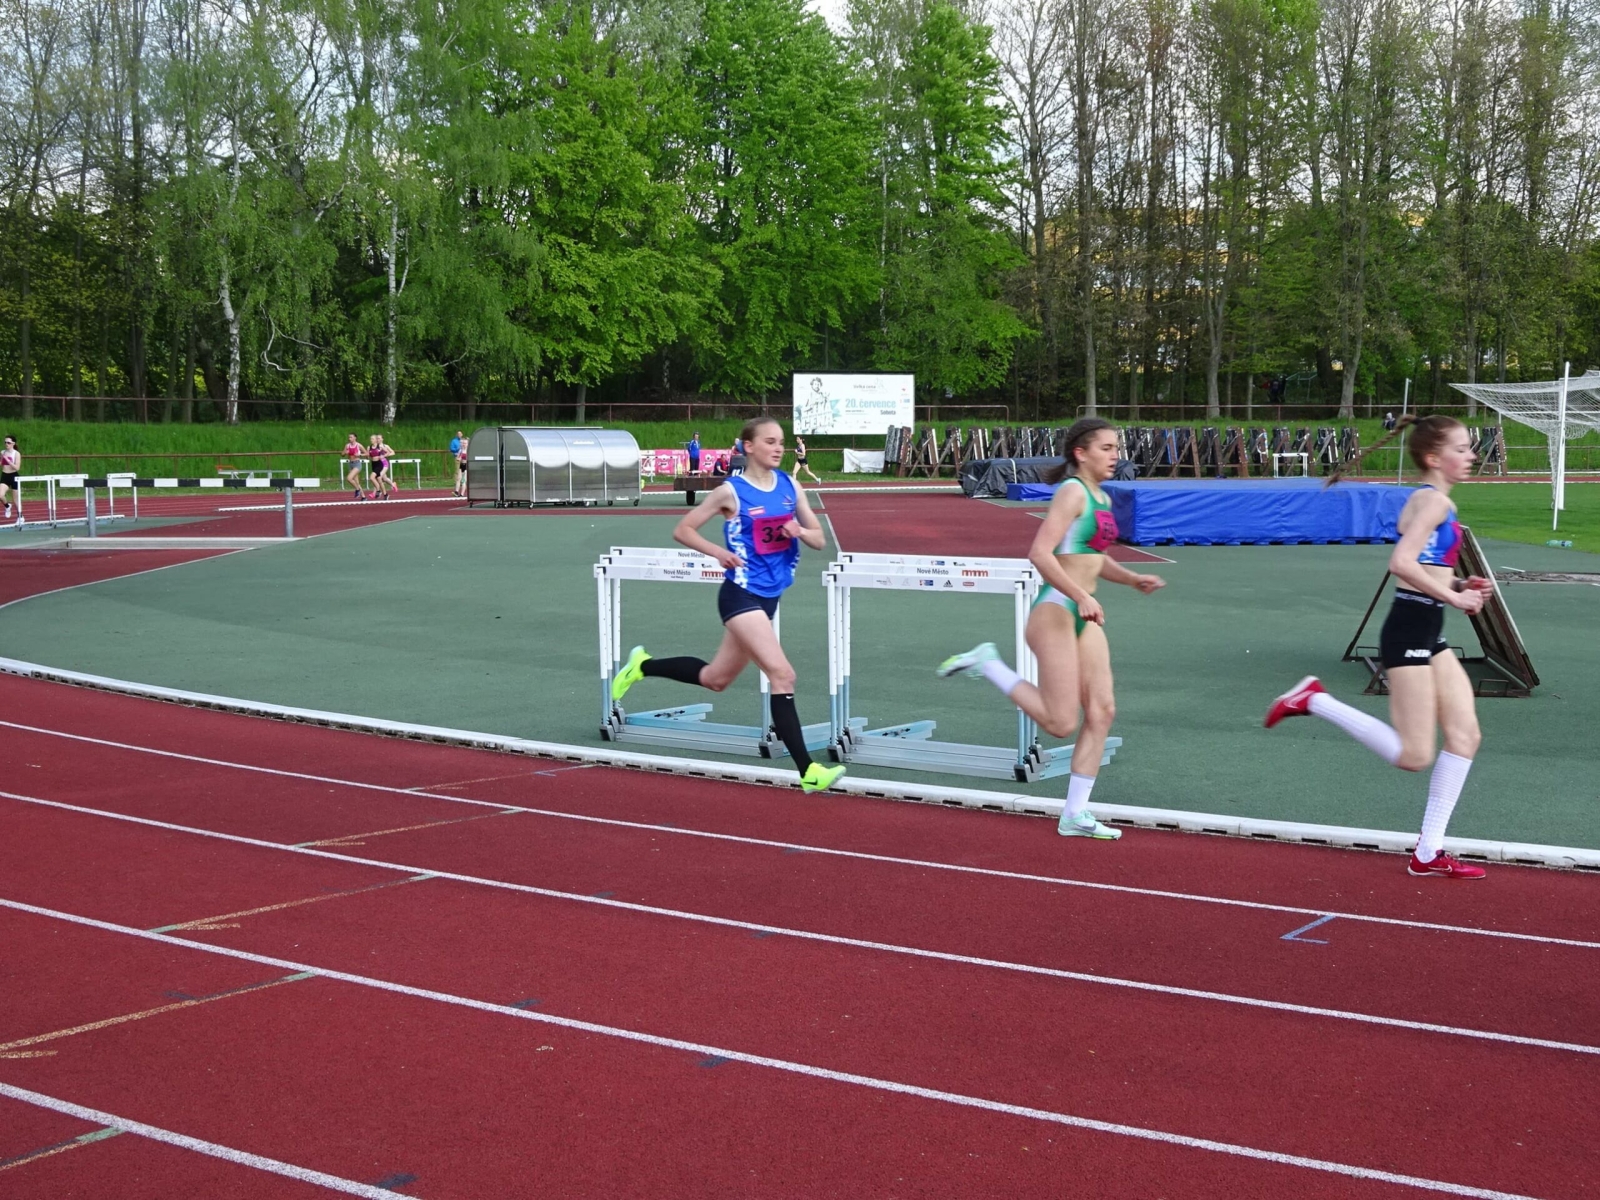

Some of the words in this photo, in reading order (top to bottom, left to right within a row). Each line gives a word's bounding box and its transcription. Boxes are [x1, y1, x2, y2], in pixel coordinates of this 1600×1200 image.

[845, 398, 858, 408] 20.
[859, 398, 896, 408] července
[931, 568, 949, 576] Město
